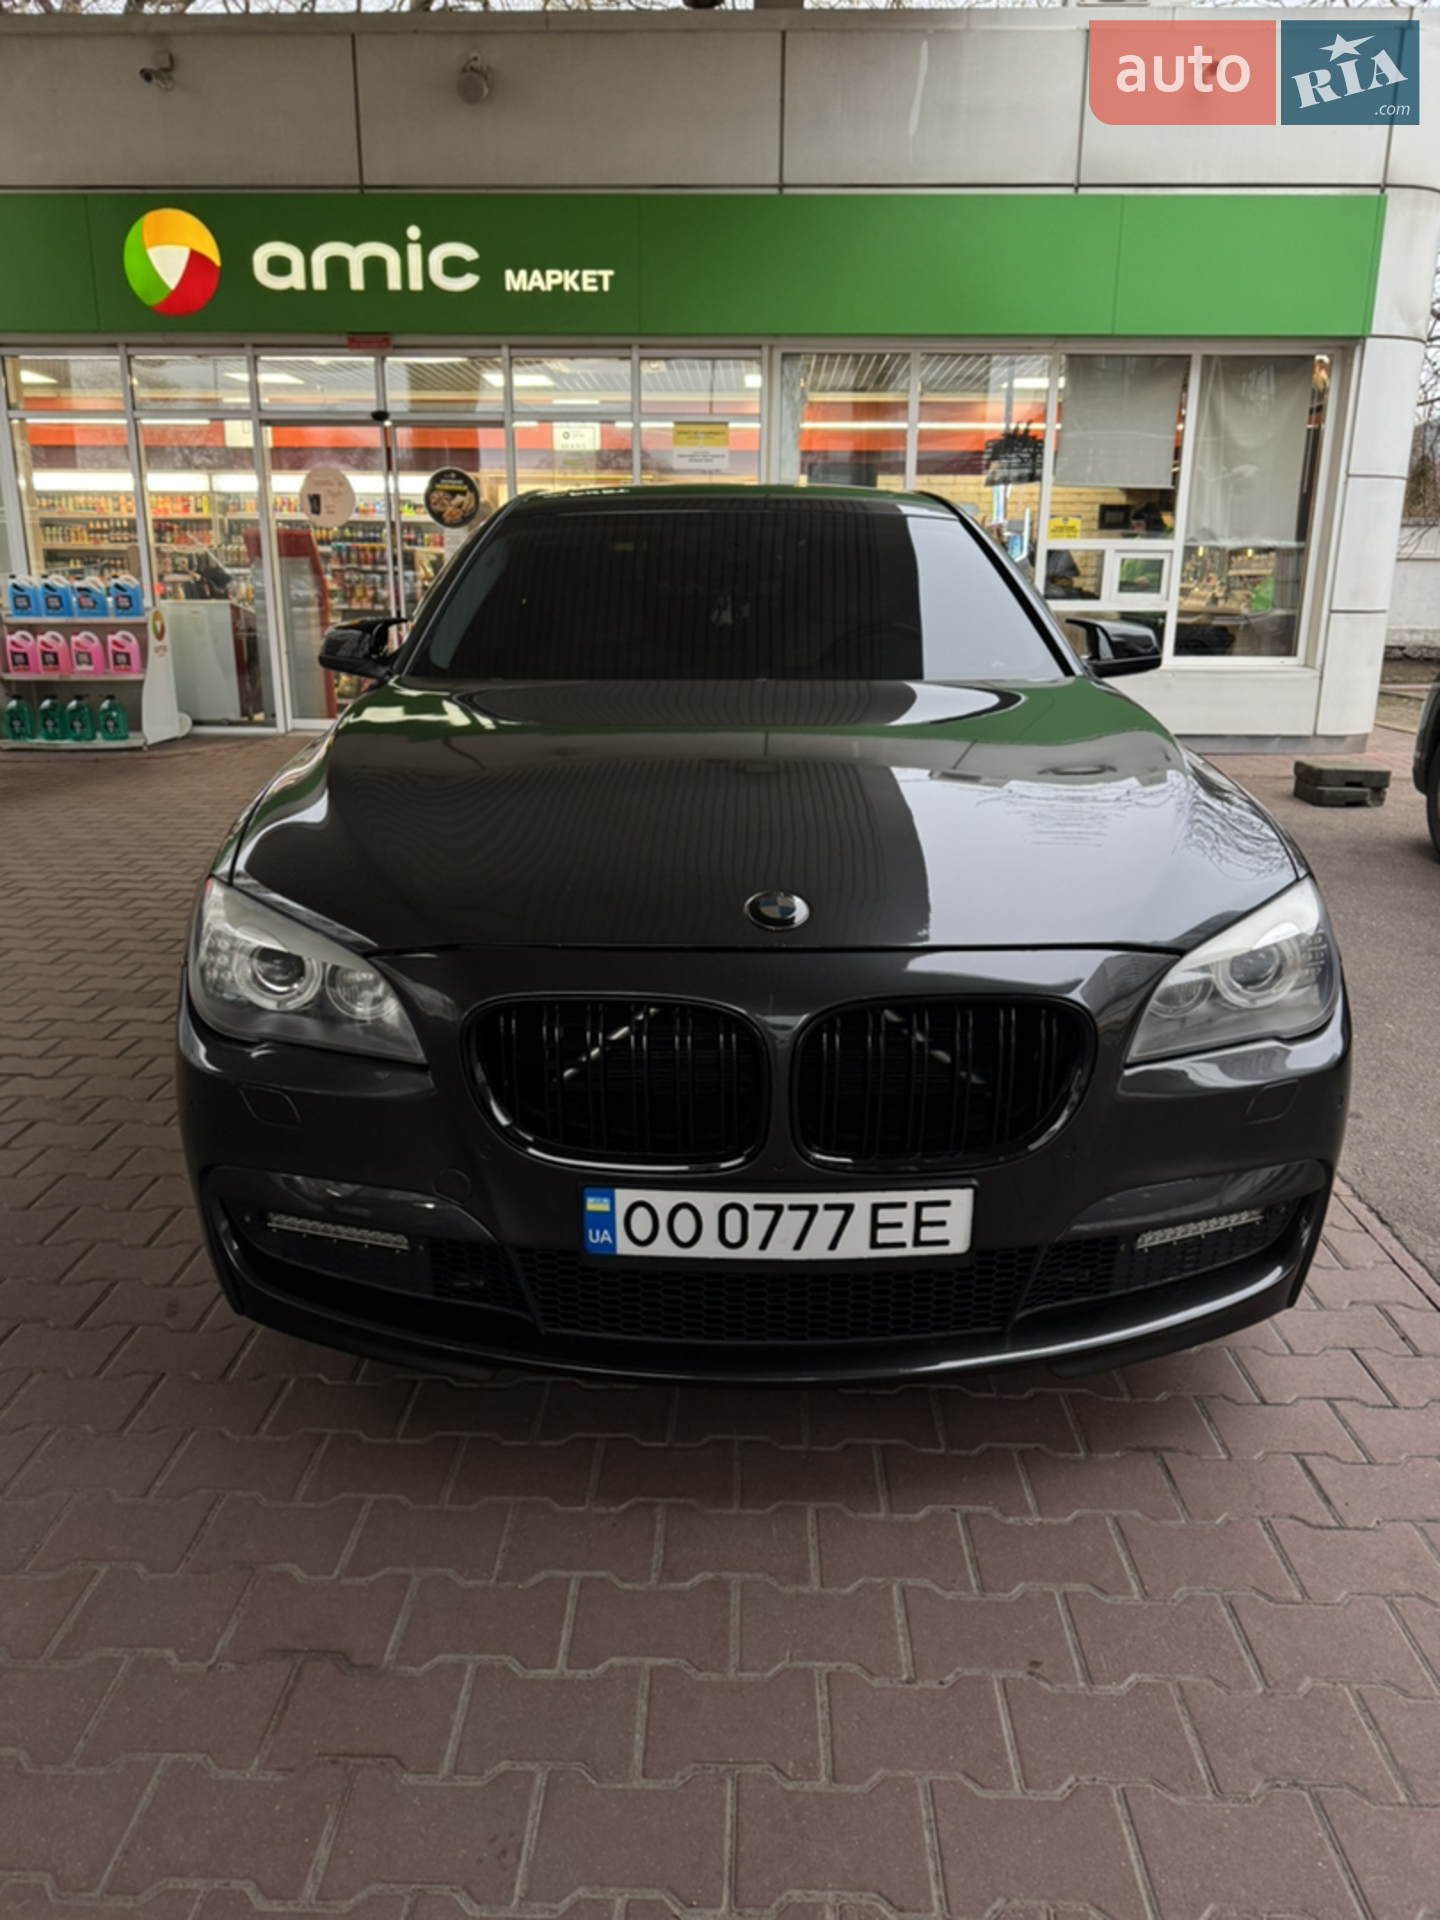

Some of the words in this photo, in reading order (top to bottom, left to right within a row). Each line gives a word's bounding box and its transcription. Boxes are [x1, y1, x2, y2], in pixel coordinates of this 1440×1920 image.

[252, 224, 480, 292] amic
[504, 269, 614, 292] МАРКЕТ
[588, 1229, 613, 1245] UA
[717, 1201, 855, 1252] 0777
[869, 1200, 952, 1250] EE
